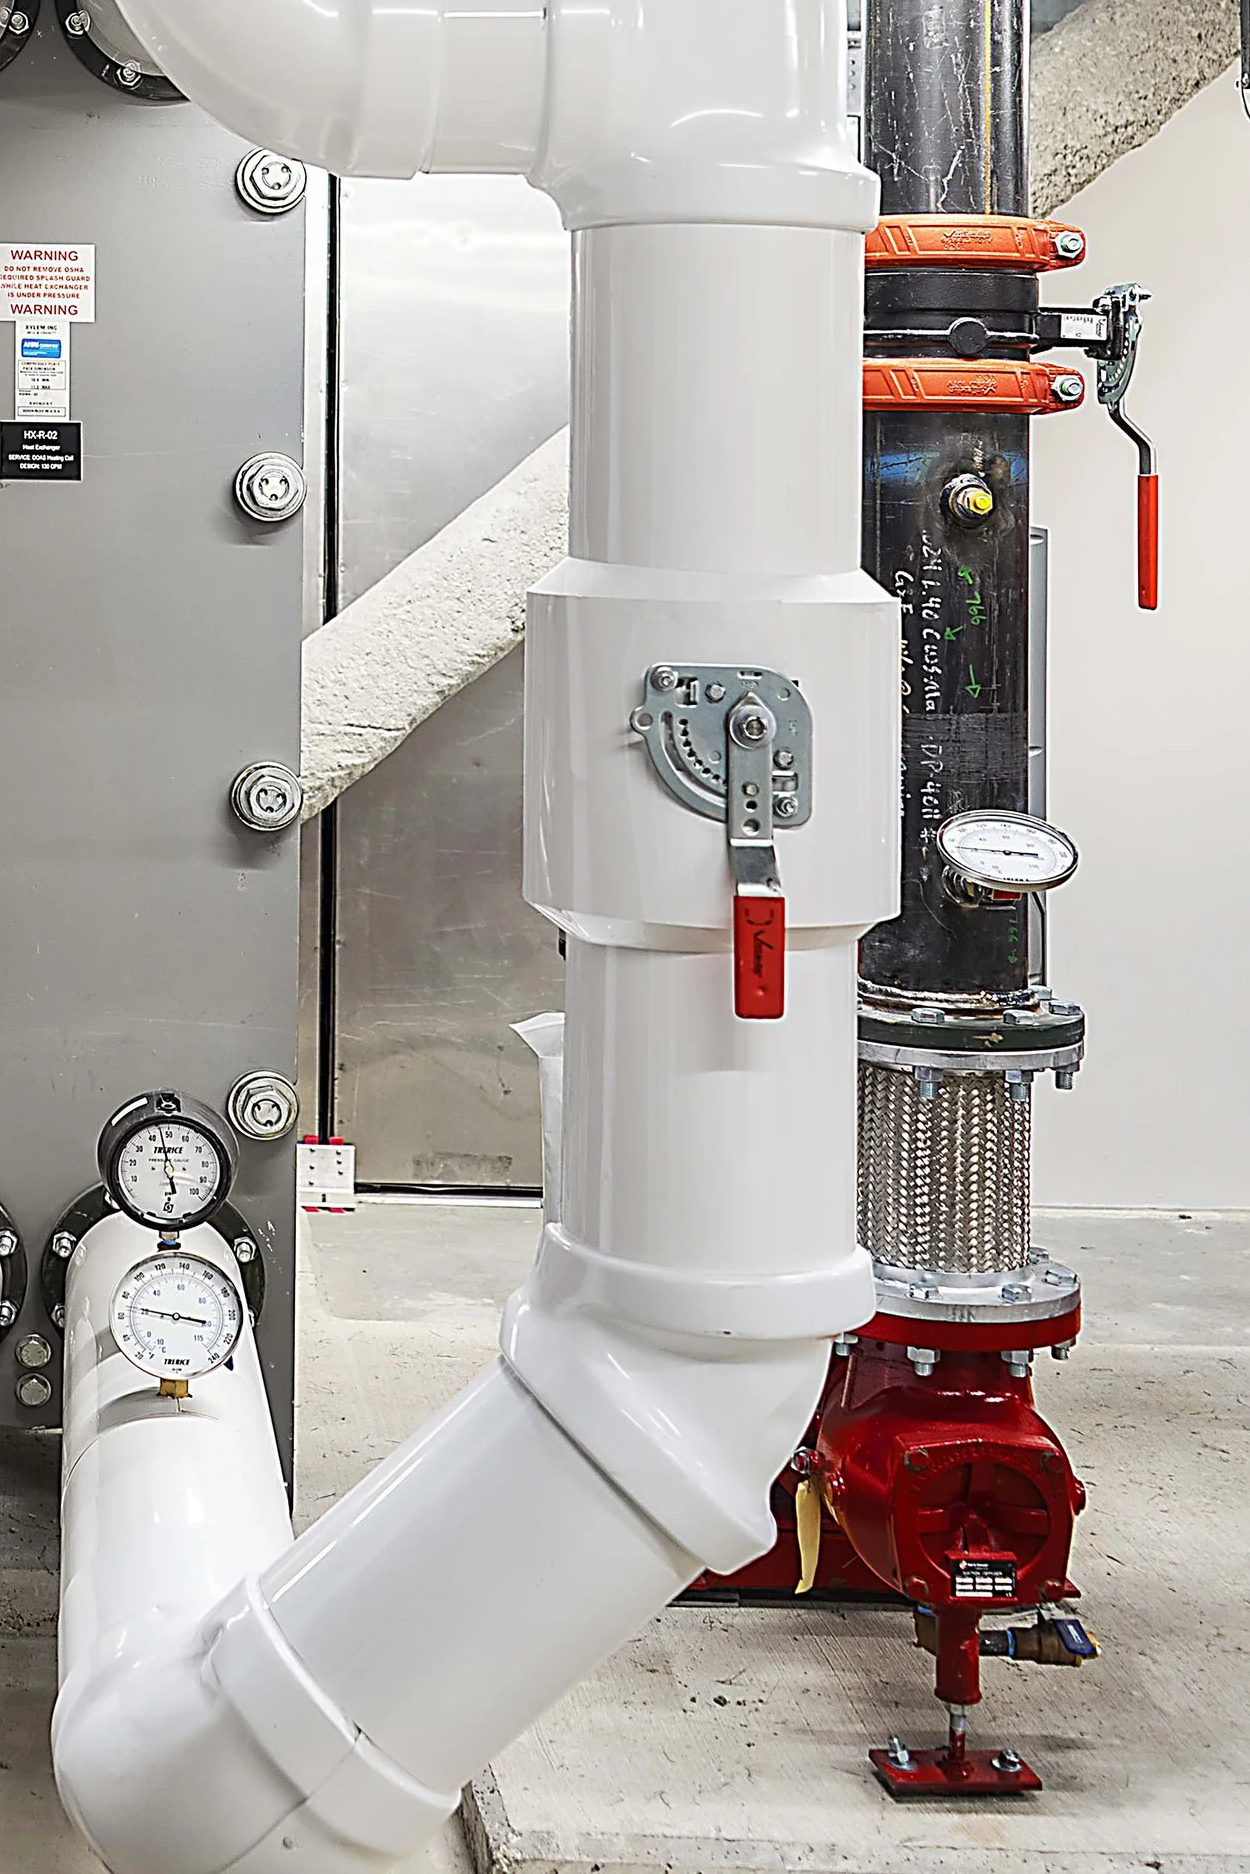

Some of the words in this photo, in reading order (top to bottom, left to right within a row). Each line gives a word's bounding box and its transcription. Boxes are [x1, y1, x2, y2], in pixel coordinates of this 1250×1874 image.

[11, 250, 78, 261] WARNING
[11, 304, 78, 315] WARNING
[24, 431, 58, 439] HX-R-02
[155, 1263, 166, 1271] 120
[179, 1262, 190, 1270] 140
[134, 1272, 145, 1282] 100
[202, 1270, 214, 1280] 160
[122, 1291, 130, 1299] 80
[221, 1287, 230, 1298] 180
[118, 1312, 125, 1320] 60
[228, 1309, 236, 1320] 200
[223, 1333, 233, 1345] 220
[135, 1351, 144, 1360] 20
[208, 1353, 220, 1364] 240
